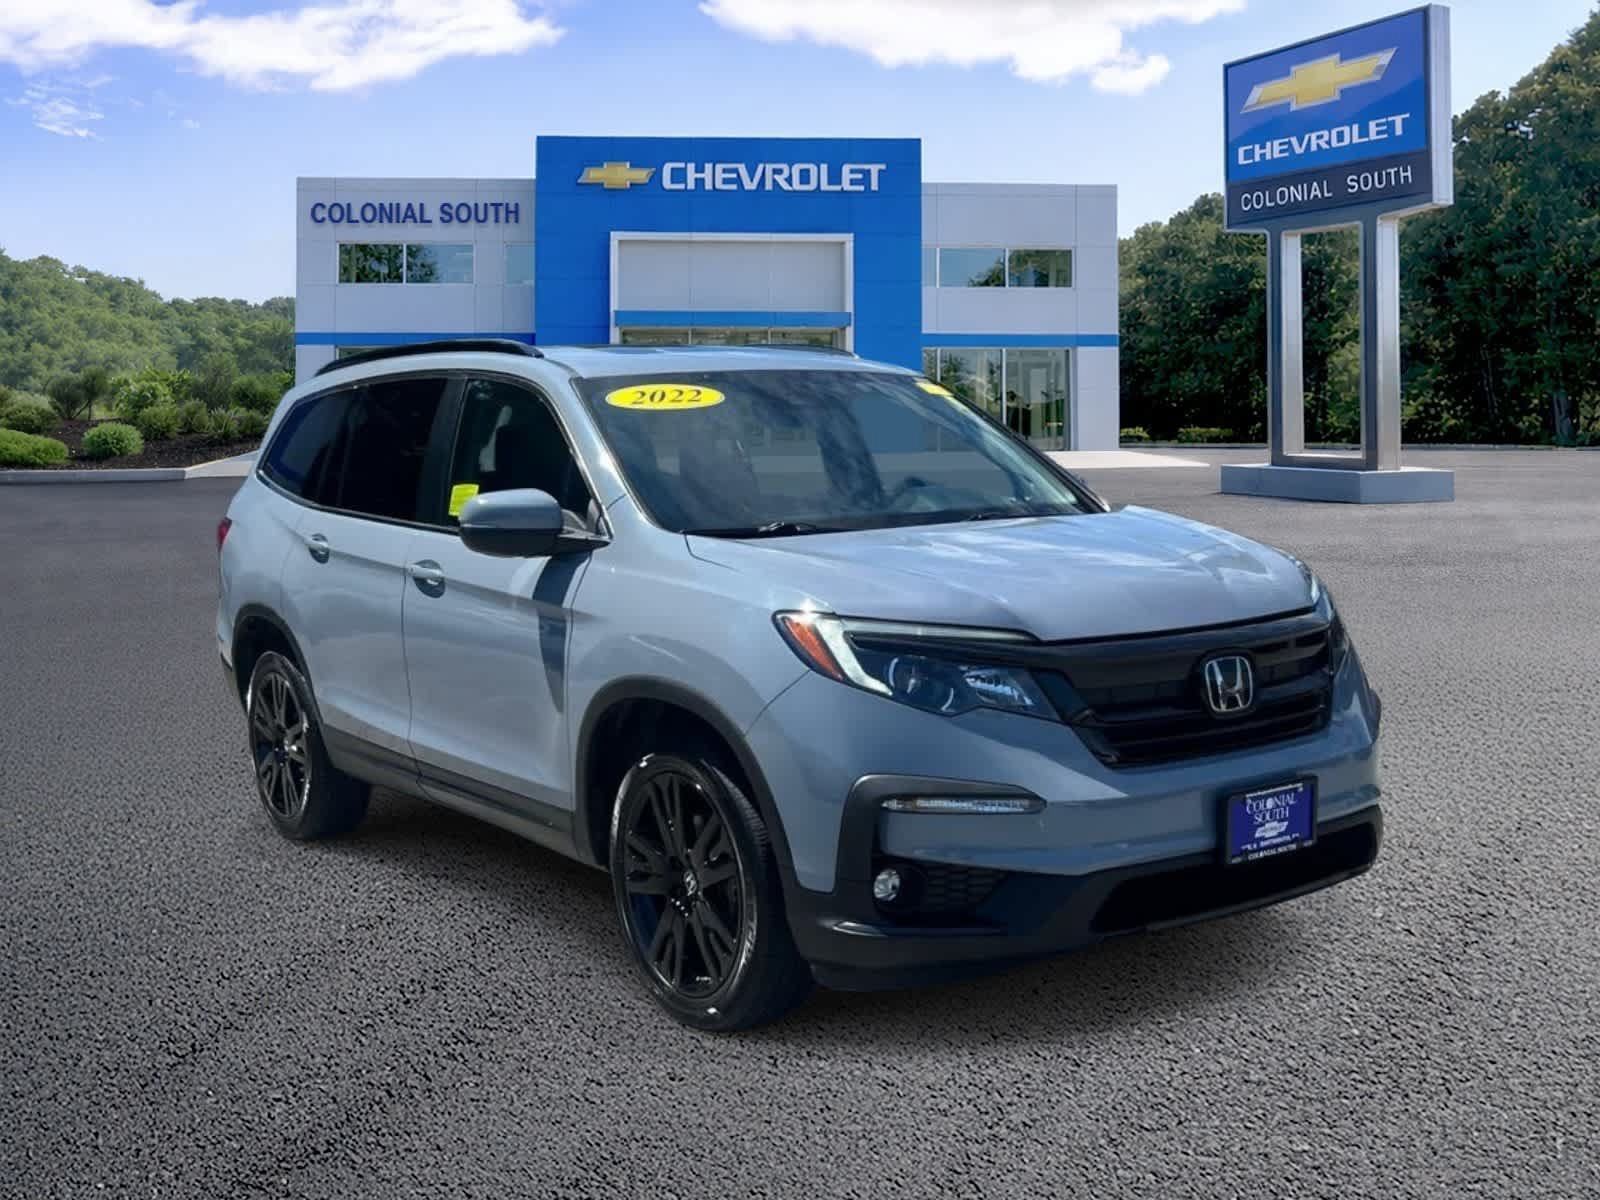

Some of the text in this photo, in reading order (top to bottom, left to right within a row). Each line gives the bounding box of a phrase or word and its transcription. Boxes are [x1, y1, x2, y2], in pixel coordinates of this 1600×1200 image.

[1238, 113, 1410, 165] CHEVROLET
[662, 162, 887, 192] CHEVROLET
[1241, 165, 1412, 212] COLONIAL SOUTH
[310, 202, 520, 224] COLONIAL SOUTH
[631, 388, 702, 405] 2022
[1246, 792, 1297, 815] COLONIAL
[1253, 806, 1289, 825] SOUTH
